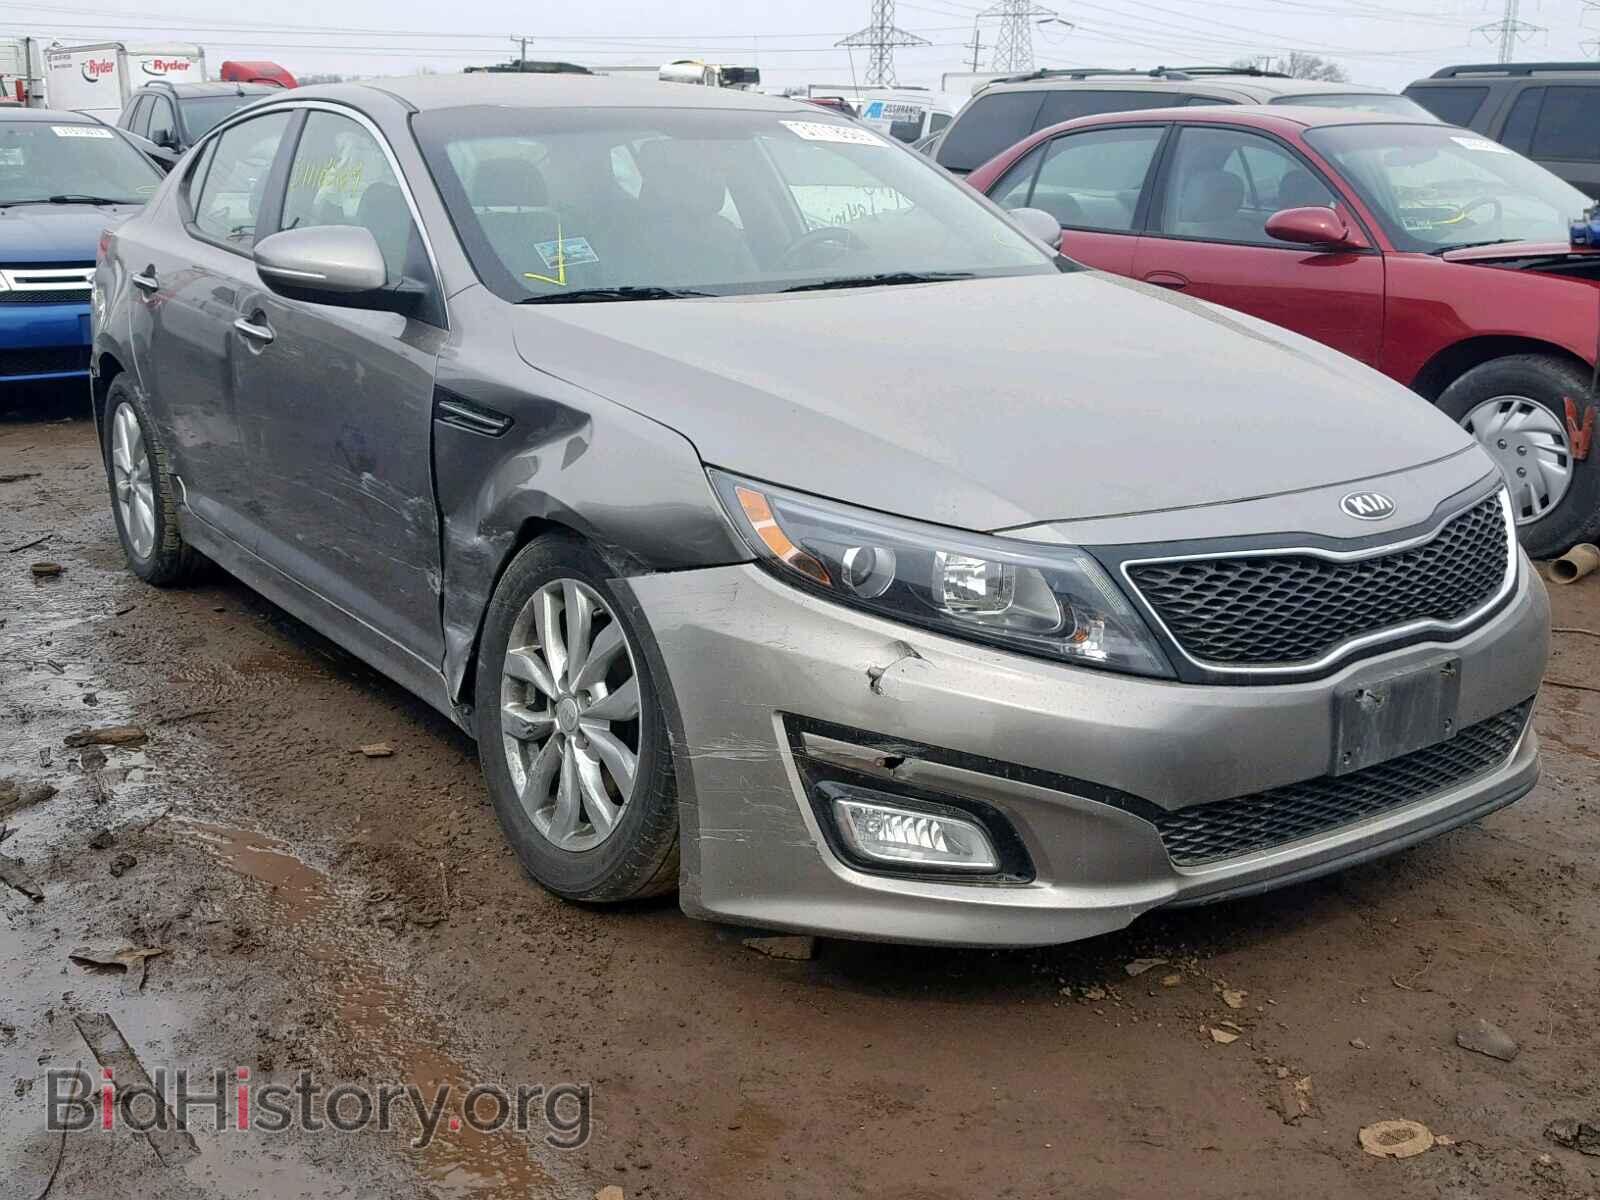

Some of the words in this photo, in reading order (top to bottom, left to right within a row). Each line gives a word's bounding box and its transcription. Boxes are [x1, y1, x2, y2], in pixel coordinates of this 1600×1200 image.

[89, 59, 114, 77] Ryder
[153, 60, 189, 71] Ryder
[1347, 494, 1393, 514] KIA
